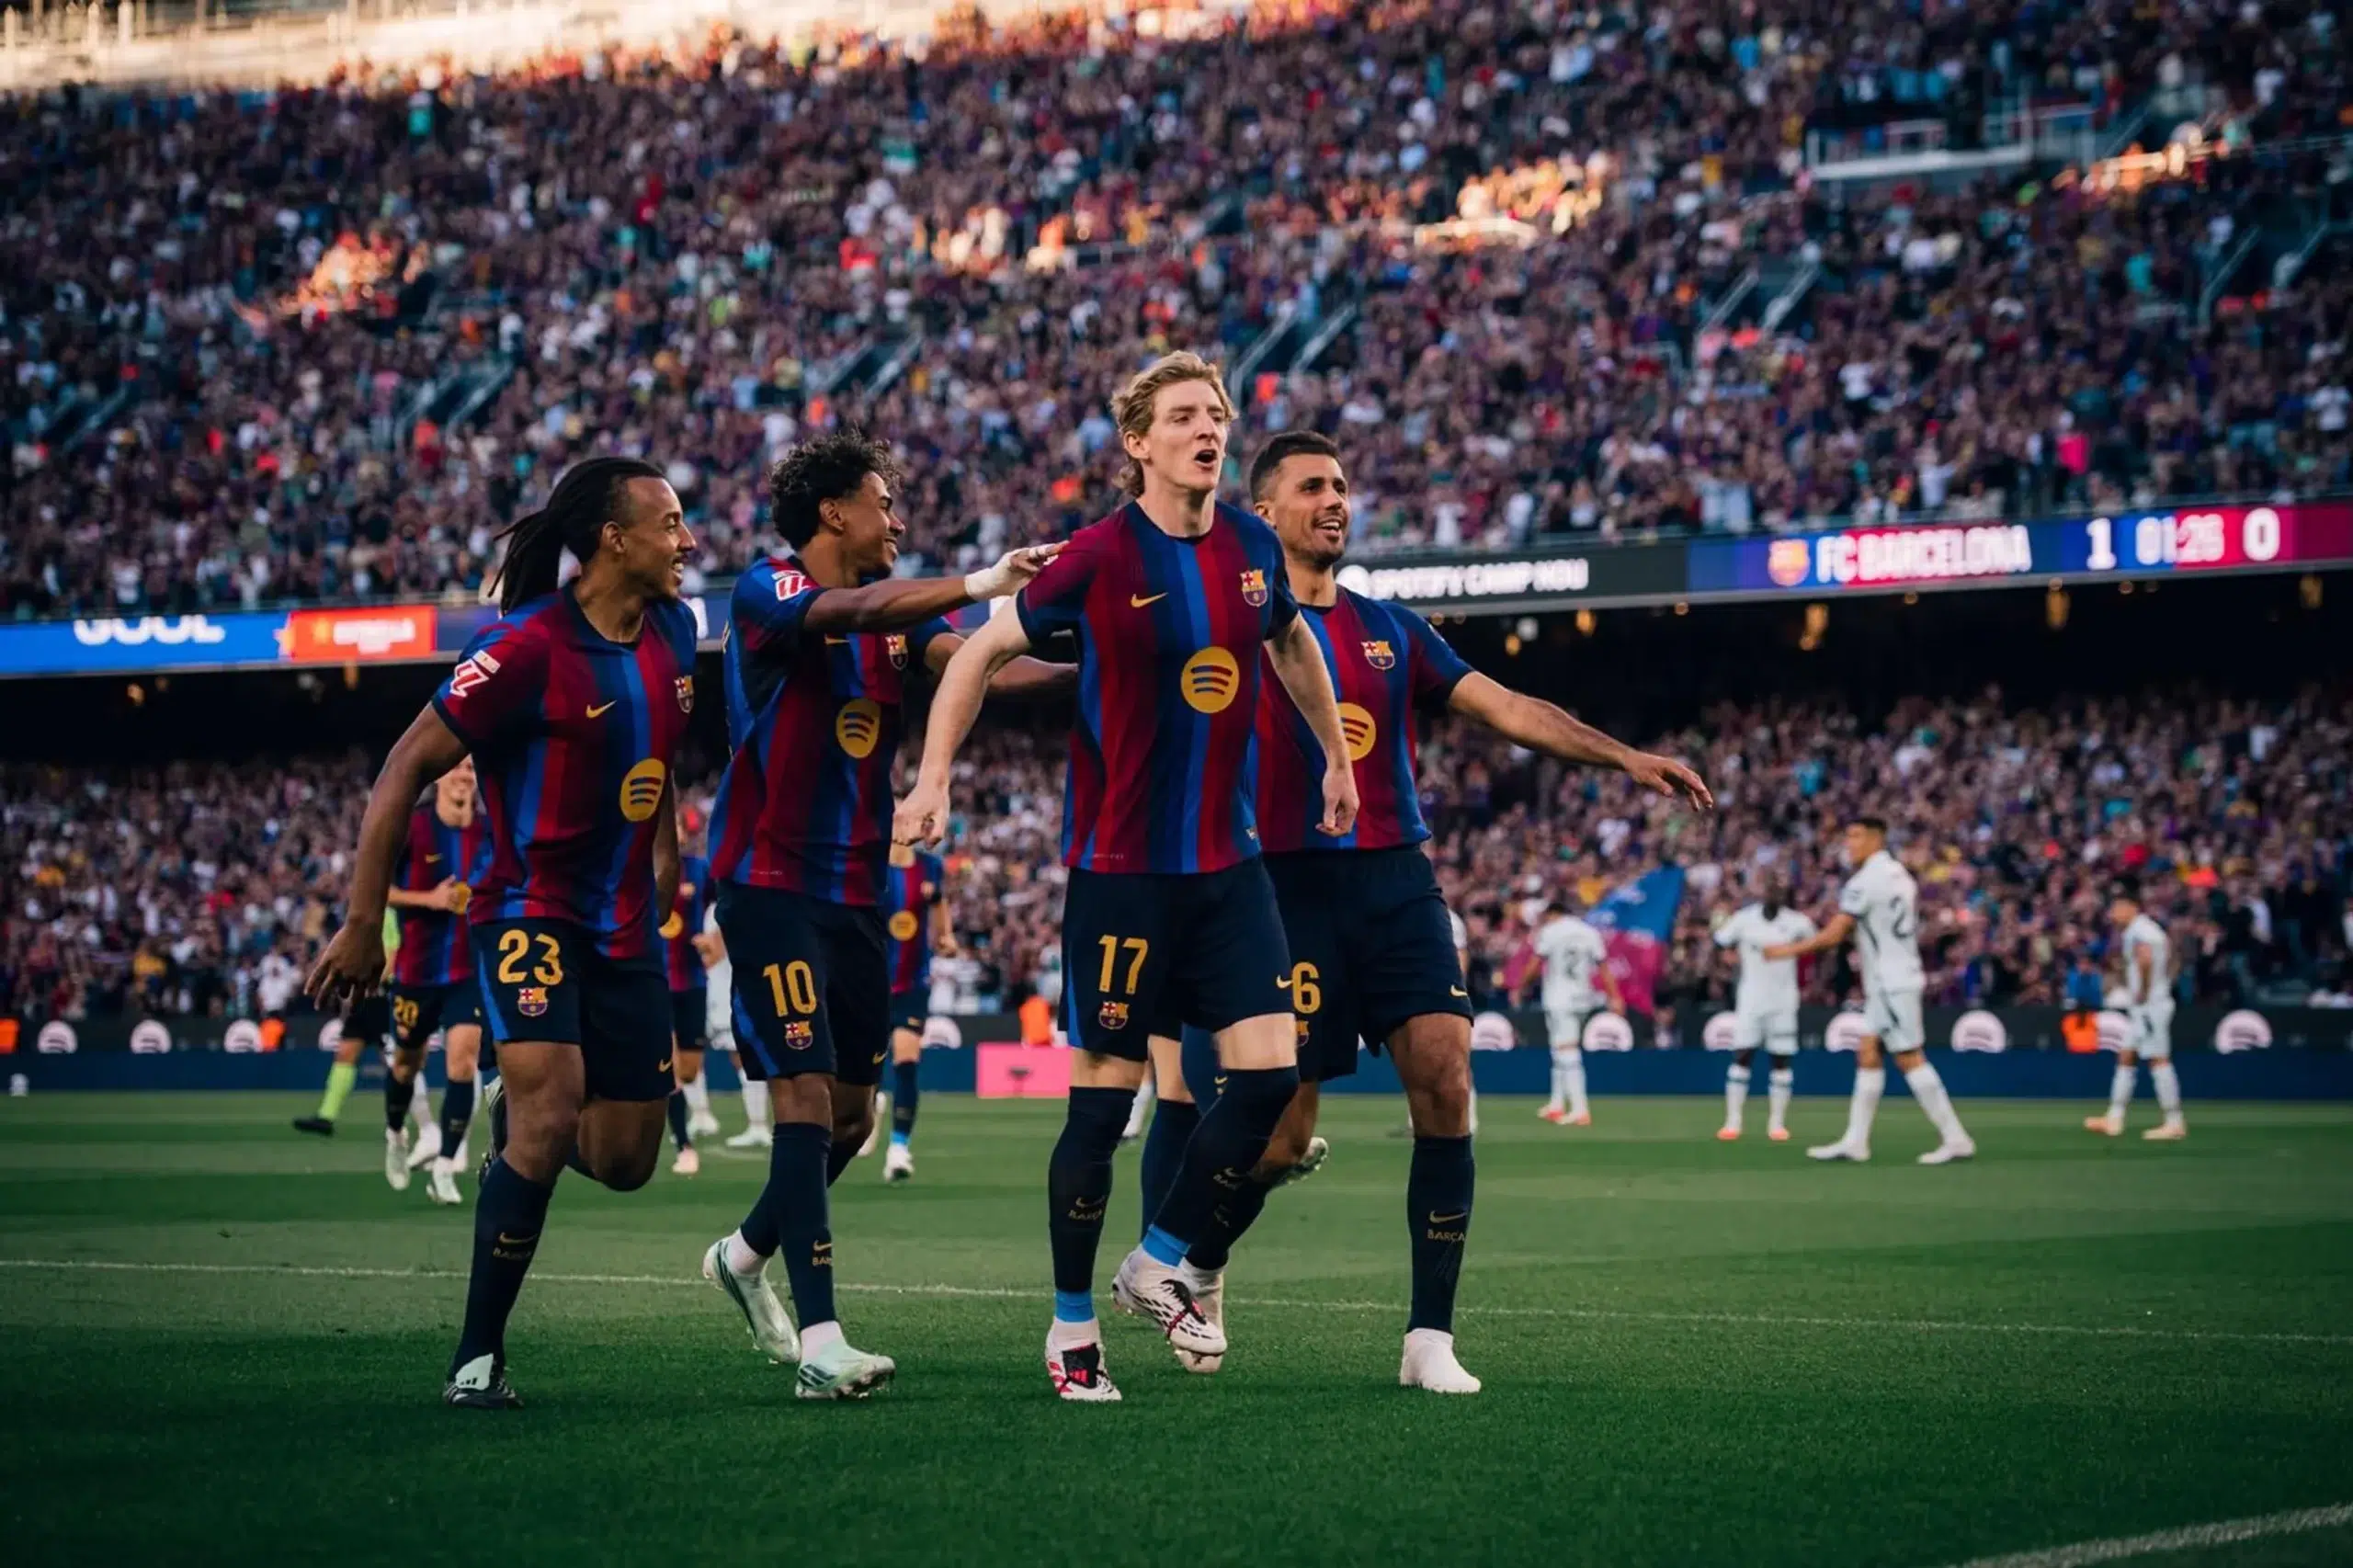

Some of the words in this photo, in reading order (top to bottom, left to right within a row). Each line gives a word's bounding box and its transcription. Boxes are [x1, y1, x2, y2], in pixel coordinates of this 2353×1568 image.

[1816, 536, 1858, 583] FC
[1858, 525, 2032, 581] BARCELONA
[2086, 517, 2117, 570] 1
[2243, 507, 2280, 562] 0
[498, 928, 563, 985] 23
[1098, 934, 1148, 994] 17
[392, 995, 418, 1027] 20
[762, 960, 816, 1017] 10
[1292, 961, 1321, 1014] 6
